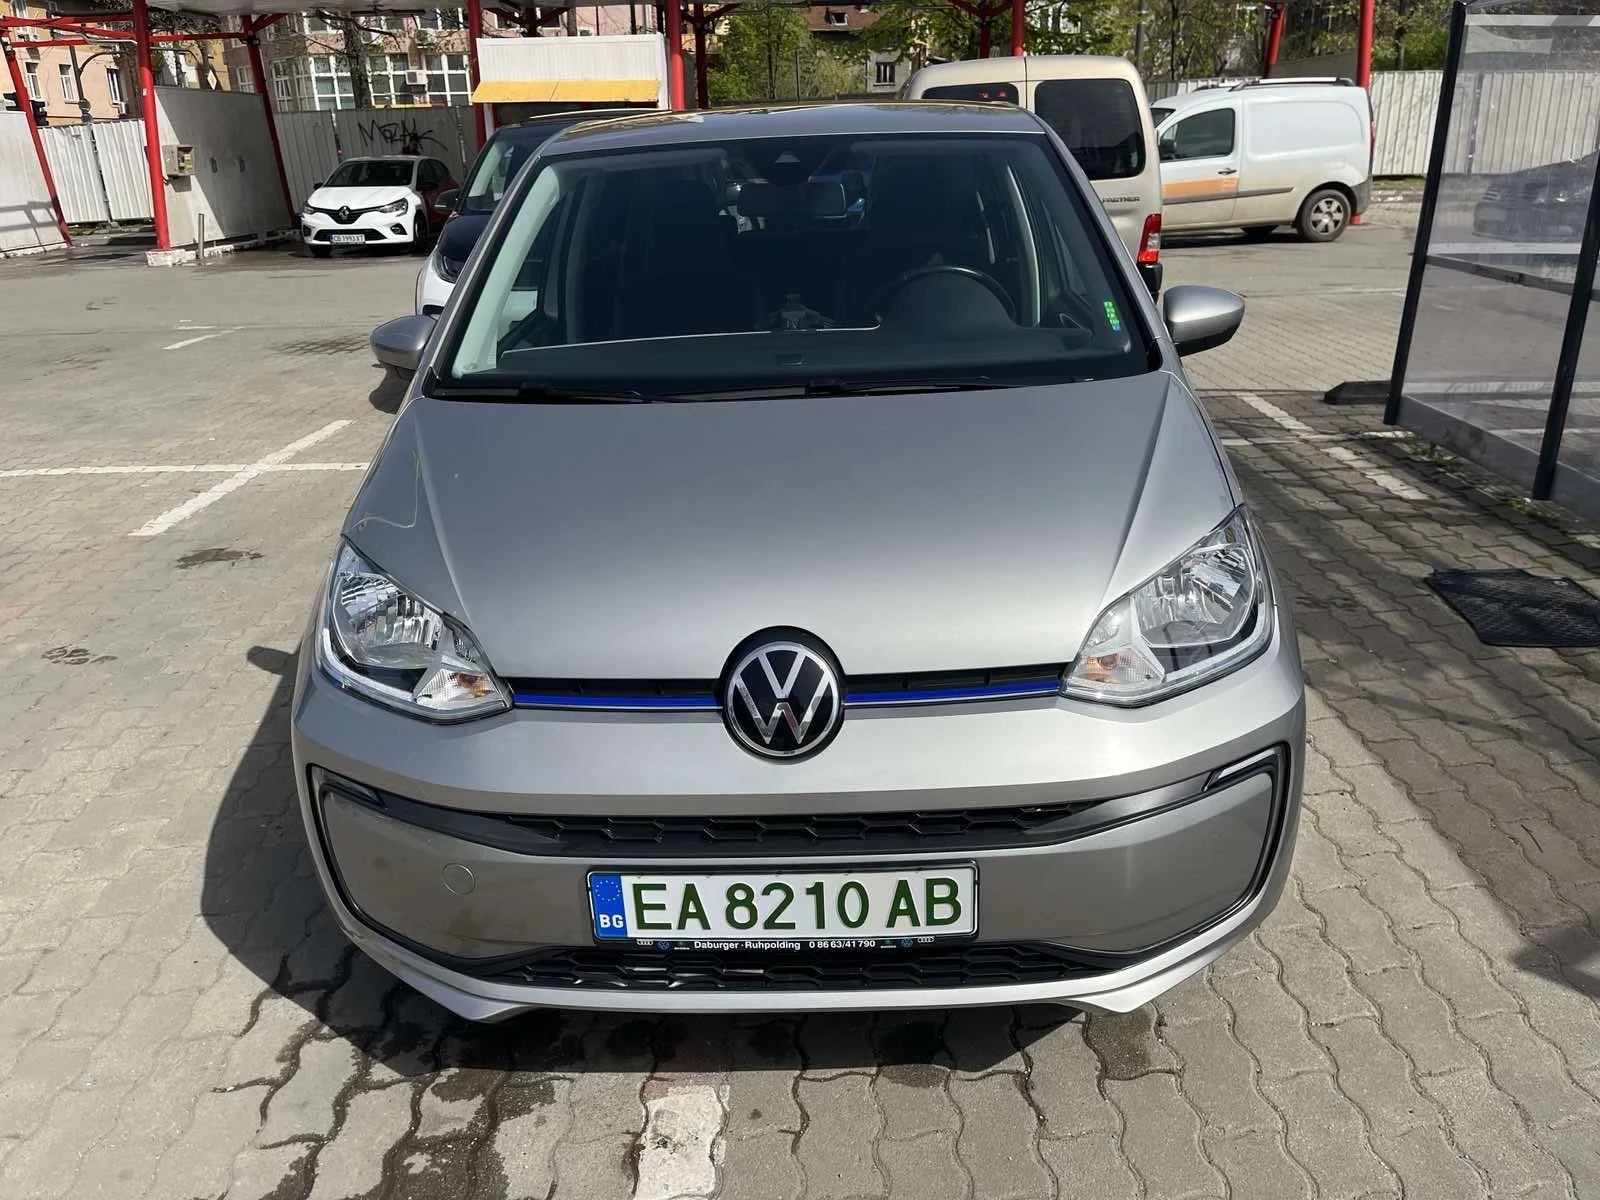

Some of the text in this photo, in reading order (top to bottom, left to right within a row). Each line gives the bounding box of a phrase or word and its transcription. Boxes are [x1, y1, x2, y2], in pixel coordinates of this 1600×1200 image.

[632, 877, 962, 930] EA 8210 AB
[599, 914, 624, 929] BG
[694, 940, 739, 950] Daburger
[745, 940, 801, 951] Ruhpolding
